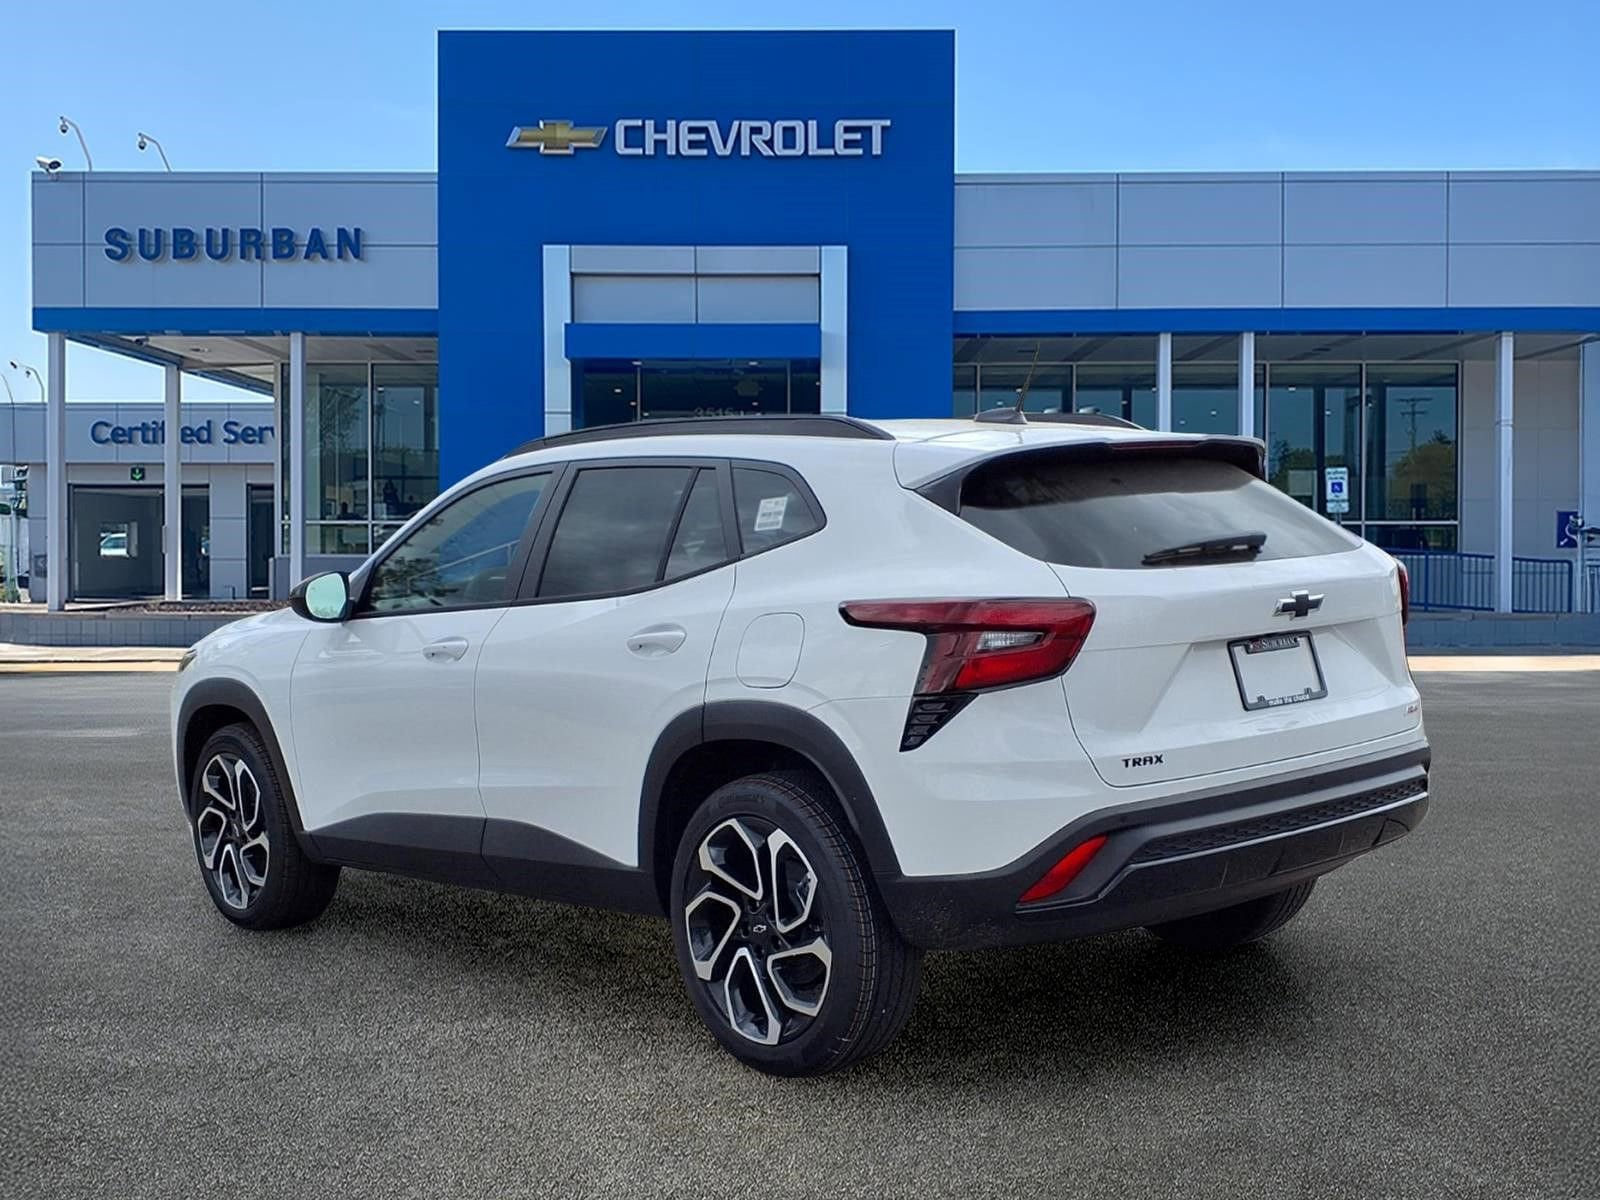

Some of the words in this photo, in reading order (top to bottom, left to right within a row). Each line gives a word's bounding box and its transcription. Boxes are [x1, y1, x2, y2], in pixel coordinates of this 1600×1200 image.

[615, 119, 891, 156] CHEVROLET
[104, 227, 363, 261] SUBURBAN
[91, 420, 213, 445] Certifed
[1121, 753, 1164, 768] TRAX
